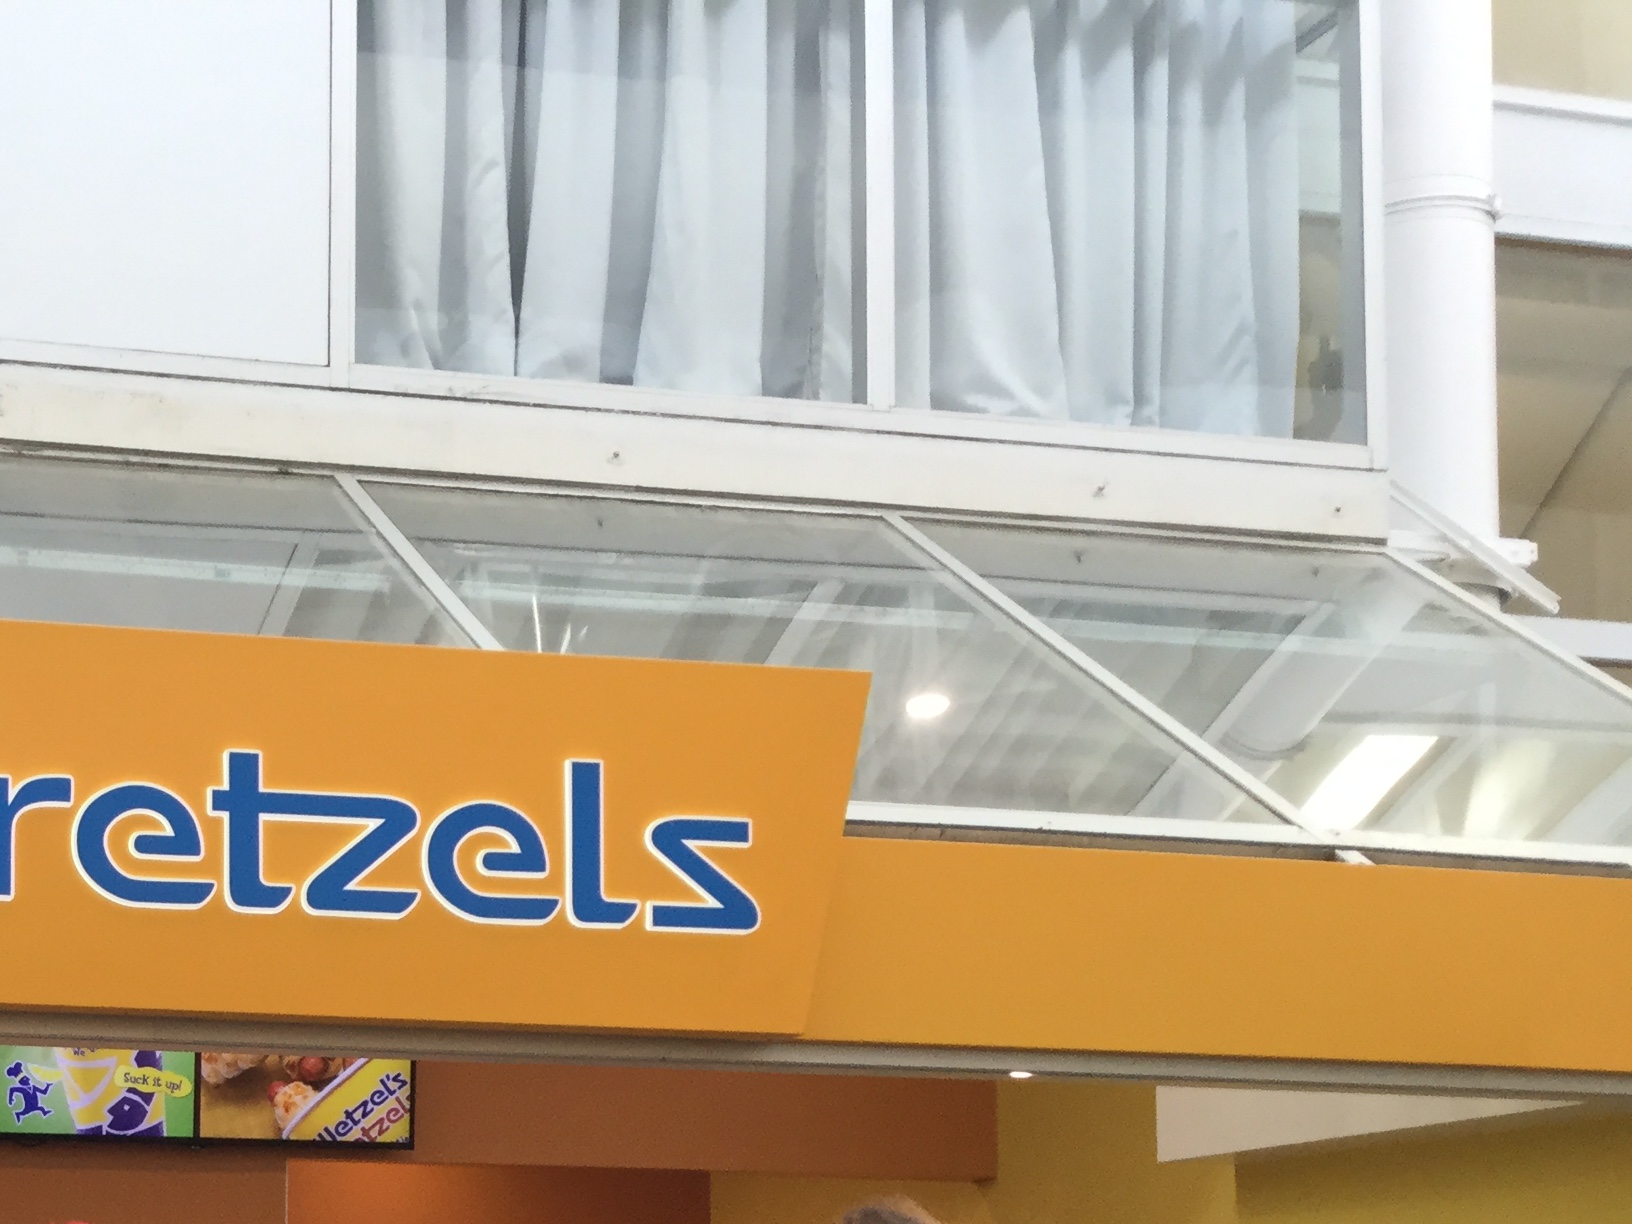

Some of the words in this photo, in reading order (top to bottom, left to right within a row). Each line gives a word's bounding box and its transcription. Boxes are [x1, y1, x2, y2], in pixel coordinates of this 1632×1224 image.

[123, 1072, 150, 1086] Suck
[152, 1073, 162, 1088] it
[164, 1079, 183, 1094] up!
